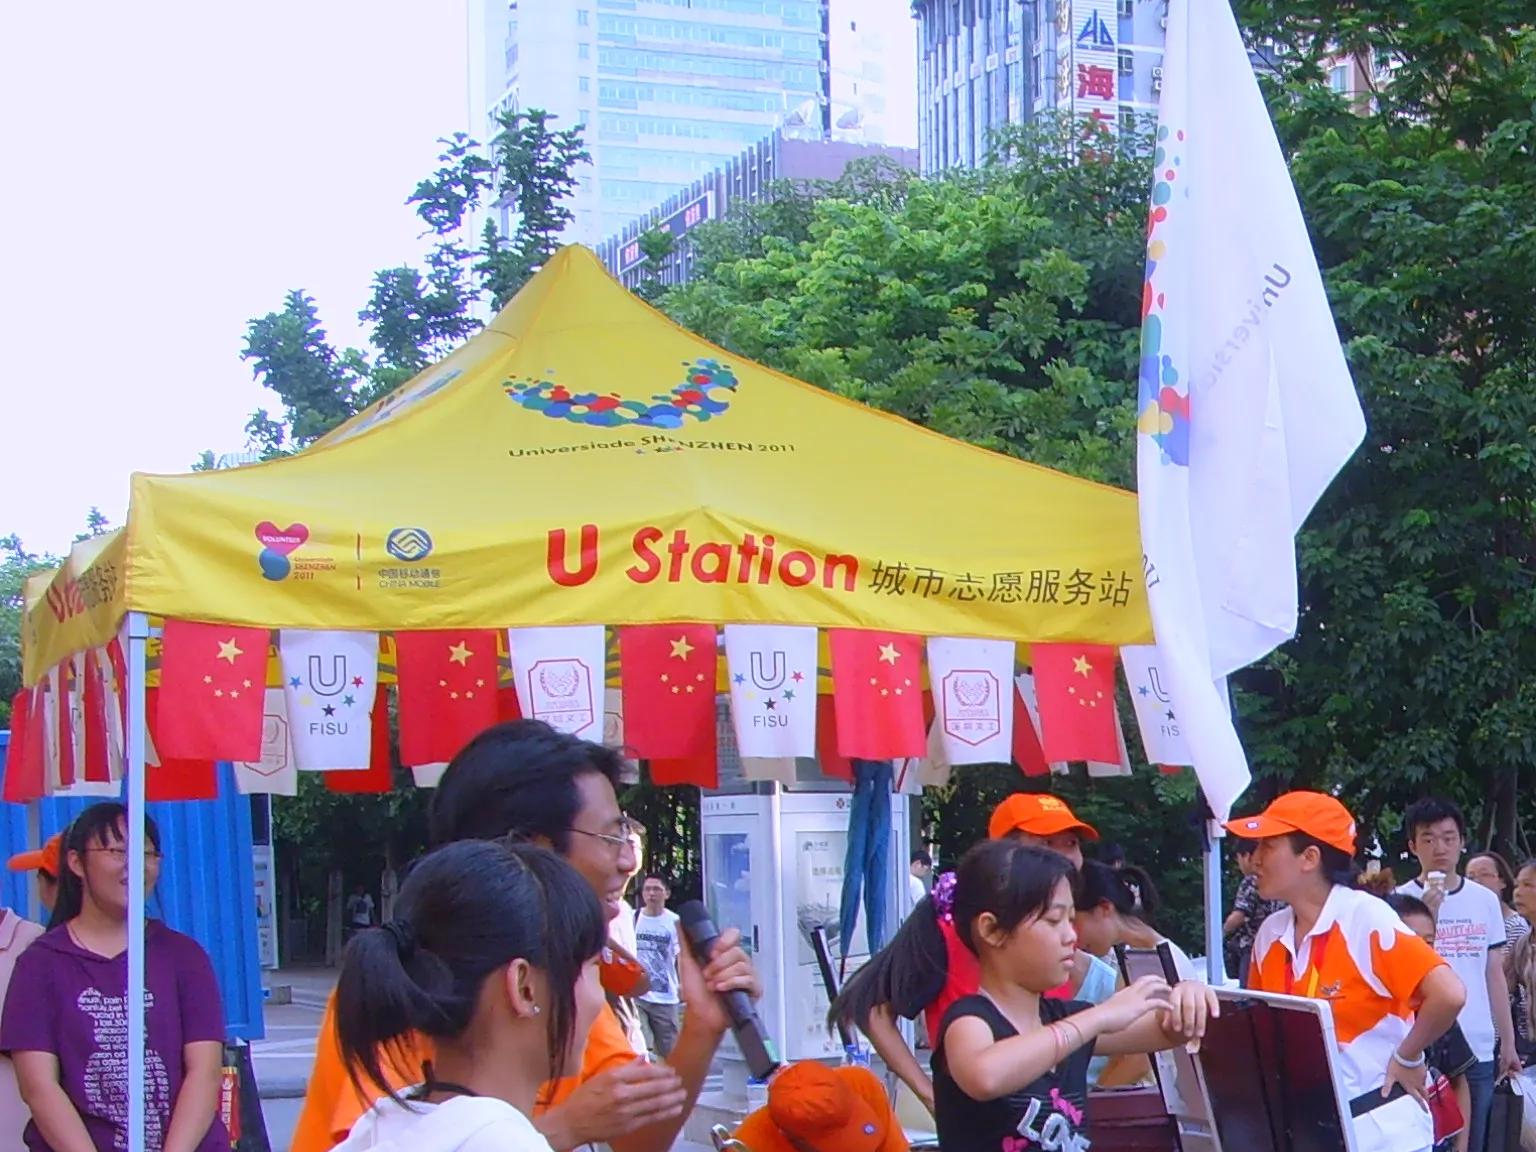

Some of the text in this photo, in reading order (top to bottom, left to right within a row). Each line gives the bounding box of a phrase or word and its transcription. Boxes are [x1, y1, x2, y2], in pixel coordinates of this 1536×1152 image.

[508, 439, 636, 457] Universiade
[758, 444, 796, 452] 2011
[546, 523, 859, 592] U Station
[868, 560, 1134, 607] 城市志愿服务站
[310, 722, 348, 735] FISU
[753, 715, 789, 727] FISU
[1161, 725, 1181, 737] FIS
